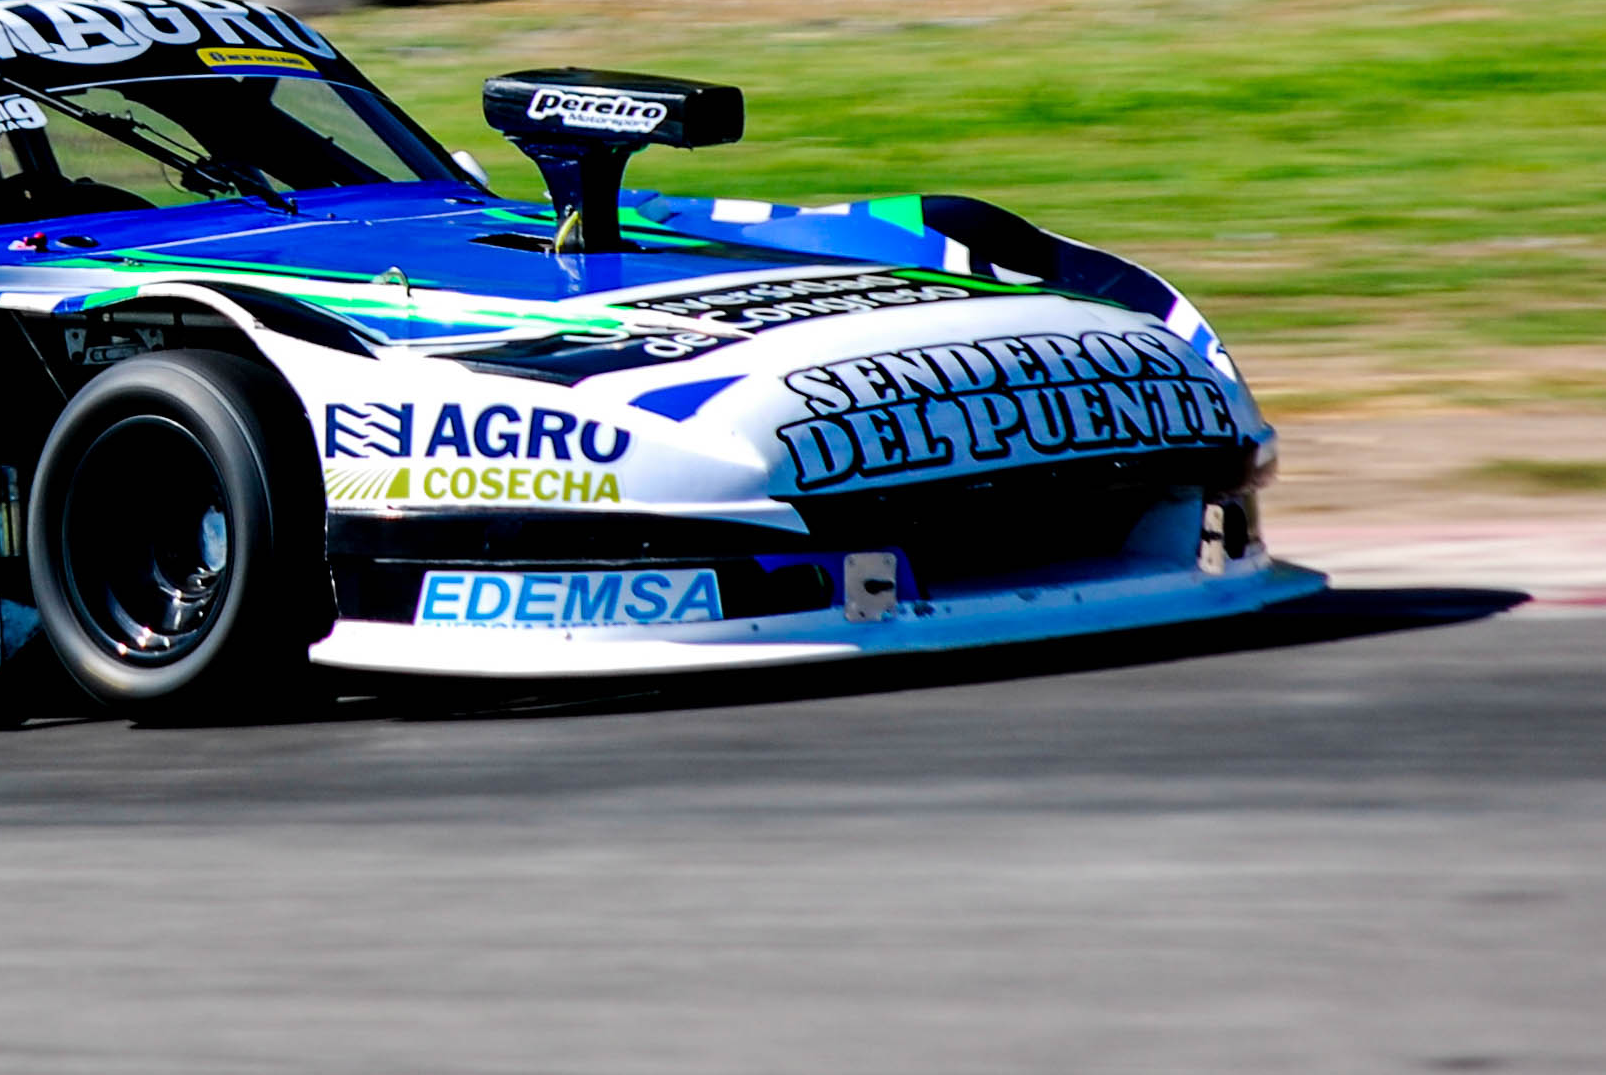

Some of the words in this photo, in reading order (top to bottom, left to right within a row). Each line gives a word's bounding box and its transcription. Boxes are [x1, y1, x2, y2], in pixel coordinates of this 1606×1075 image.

[5, 97, 48, 129] 9
[535, 94, 661, 118] pereiro
[644, 332, 719, 358] de
[785, 331, 1186, 419] SENDEROS
[424, 402, 631, 464] AGRO
[776, 403, 954, 491] DEL
[956, 378, 1239, 461] PUENTE
[422, 467, 621, 503] COSECHA
[421, 571, 724, 622] EDEMSA
